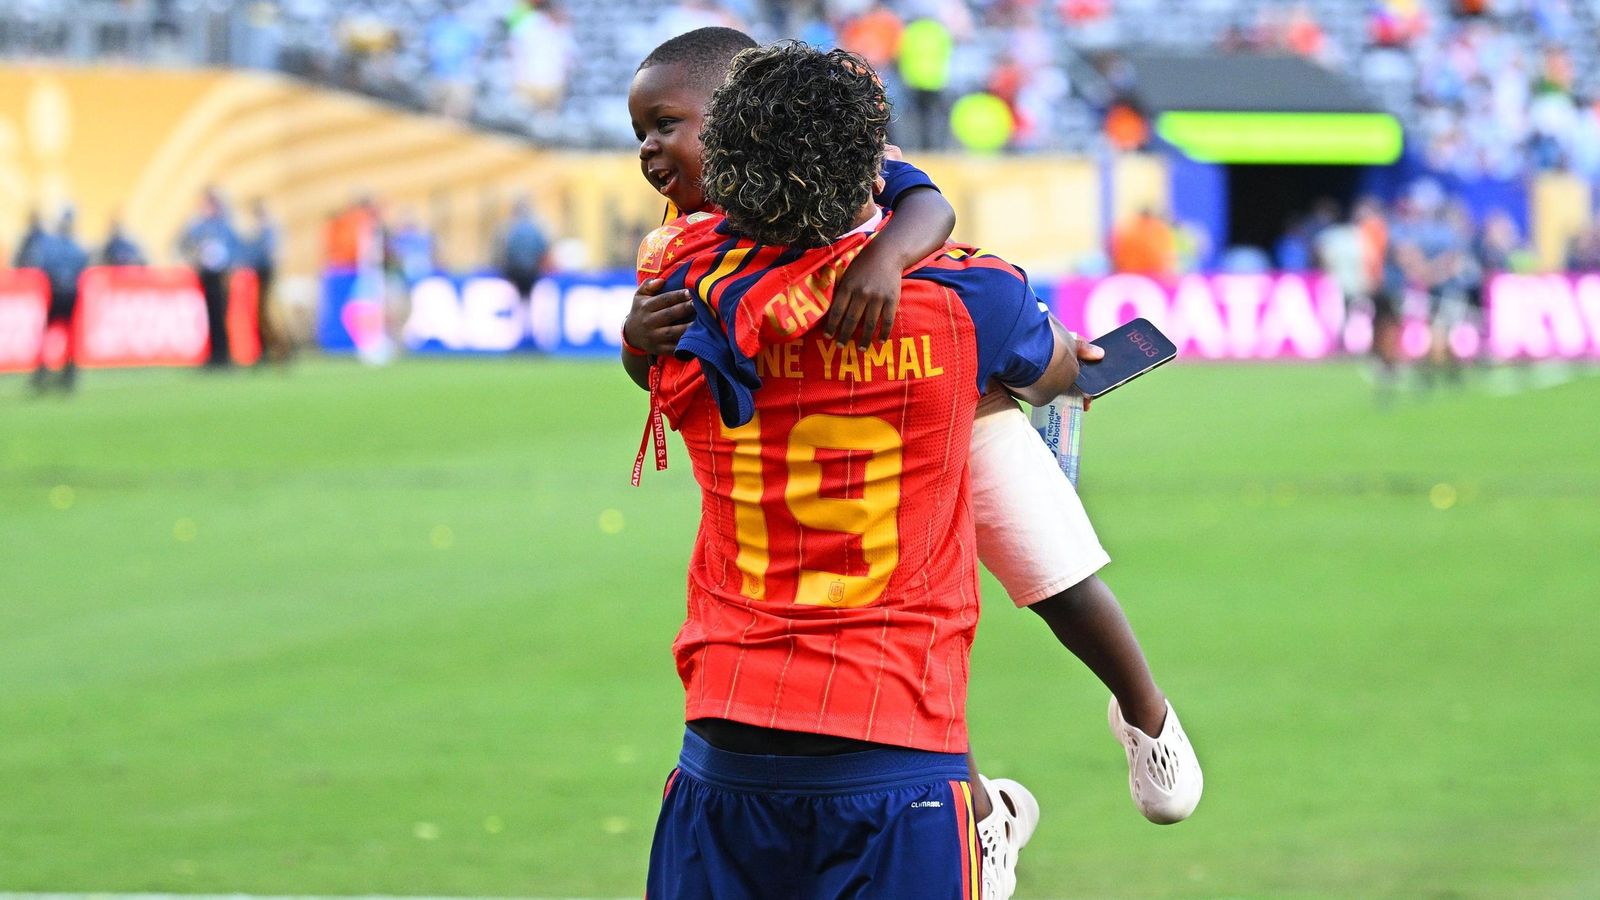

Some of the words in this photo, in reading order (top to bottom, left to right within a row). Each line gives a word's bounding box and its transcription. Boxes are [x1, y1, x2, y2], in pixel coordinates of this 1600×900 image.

[756, 339, 804, 379] NE
[815, 335, 944, 382] YAMAL
[1126, 329, 1160, 358] 19:03
[653, 404, 665, 447] RIENDS
[1047, 405, 1056, 437] recycled
[657, 449, 666, 458] &
[719, 409, 903, 608] 19
